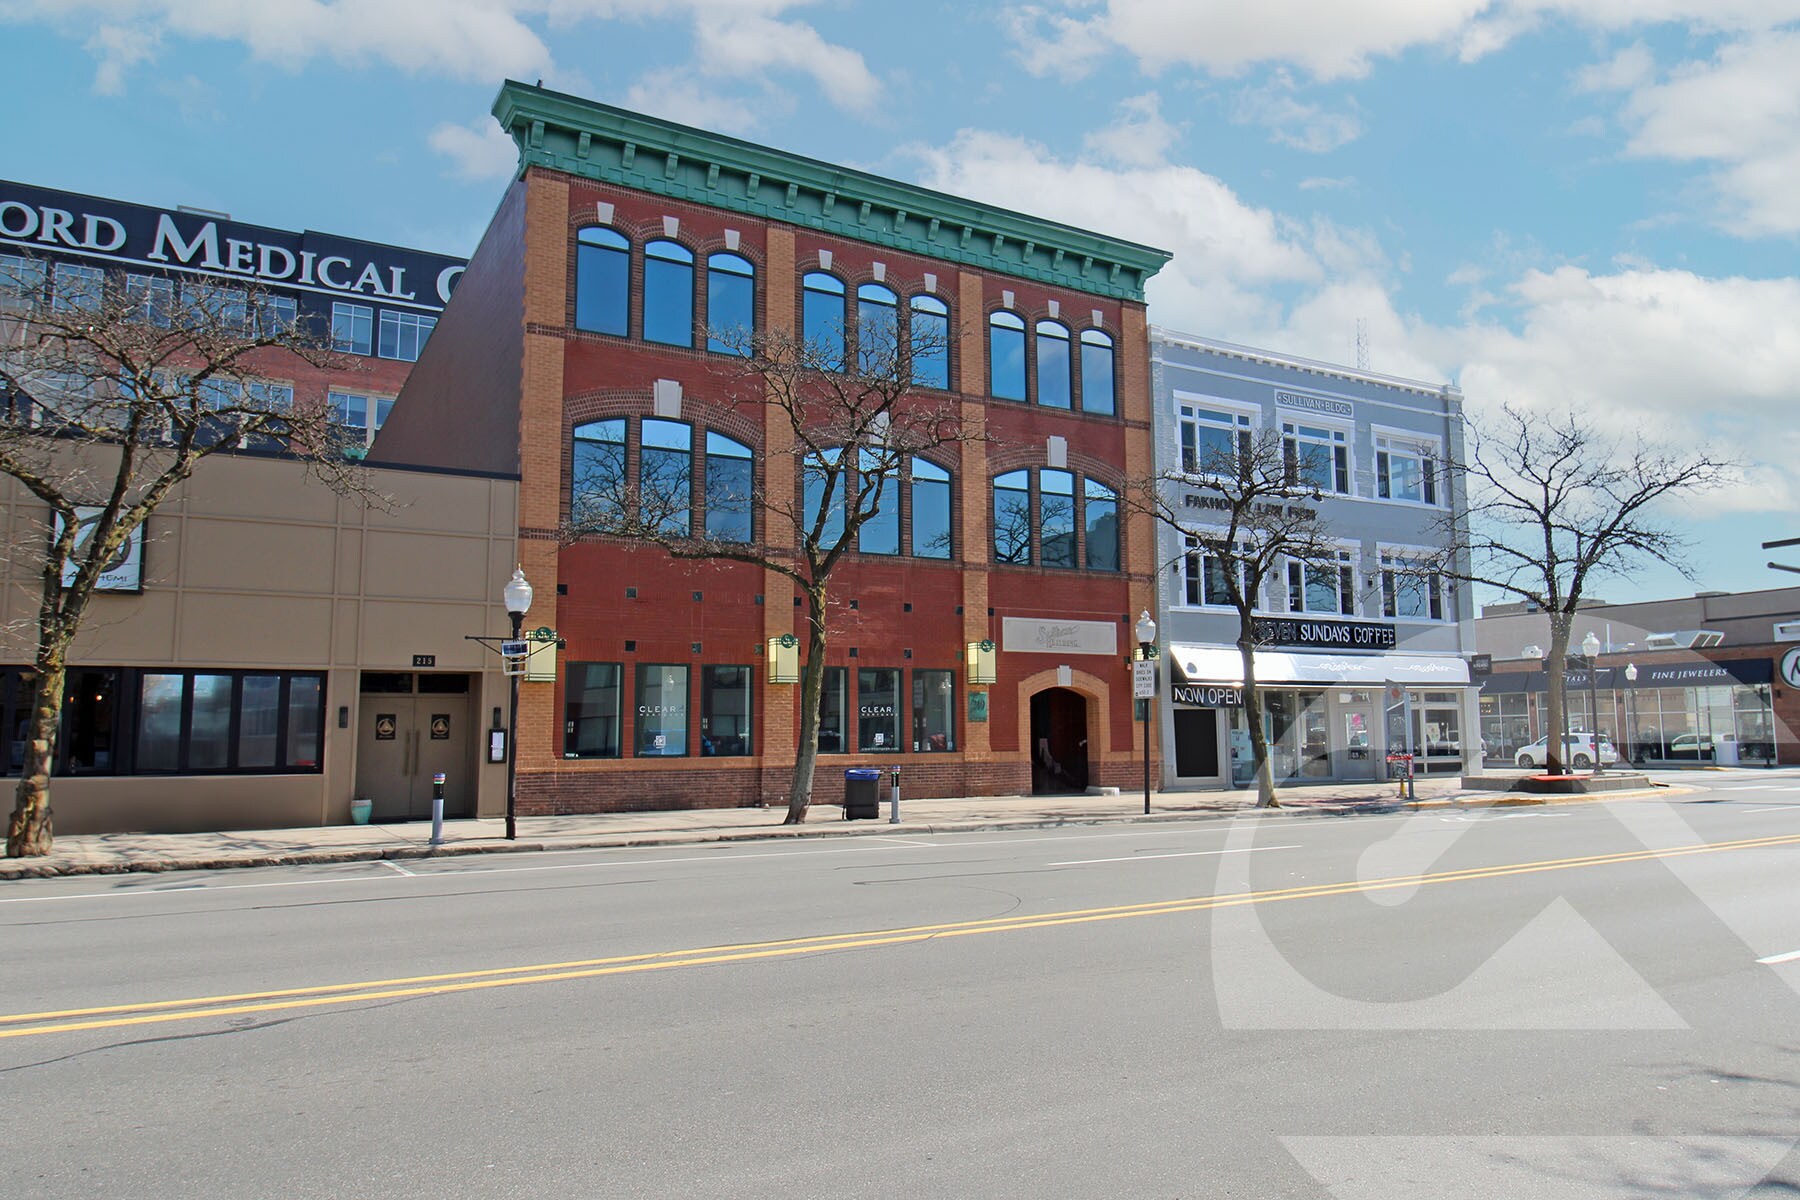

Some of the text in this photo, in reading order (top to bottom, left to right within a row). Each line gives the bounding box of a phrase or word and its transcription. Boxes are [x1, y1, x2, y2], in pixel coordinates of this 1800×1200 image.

[147, 213, 415, 301] MEDICAL
[1282, 393, 1321, 409] SULLIVAN
[1258, 620, 1395, 645] SEVEN SUNDAYS COFFEE
[416, 657, 433, 665] 215
[1652, 668, 1728, 680] FINE JEWELERS
[1174, 687, 1242, 705] NOW OPEN
[639, 705, 677, 713] CLEAR
